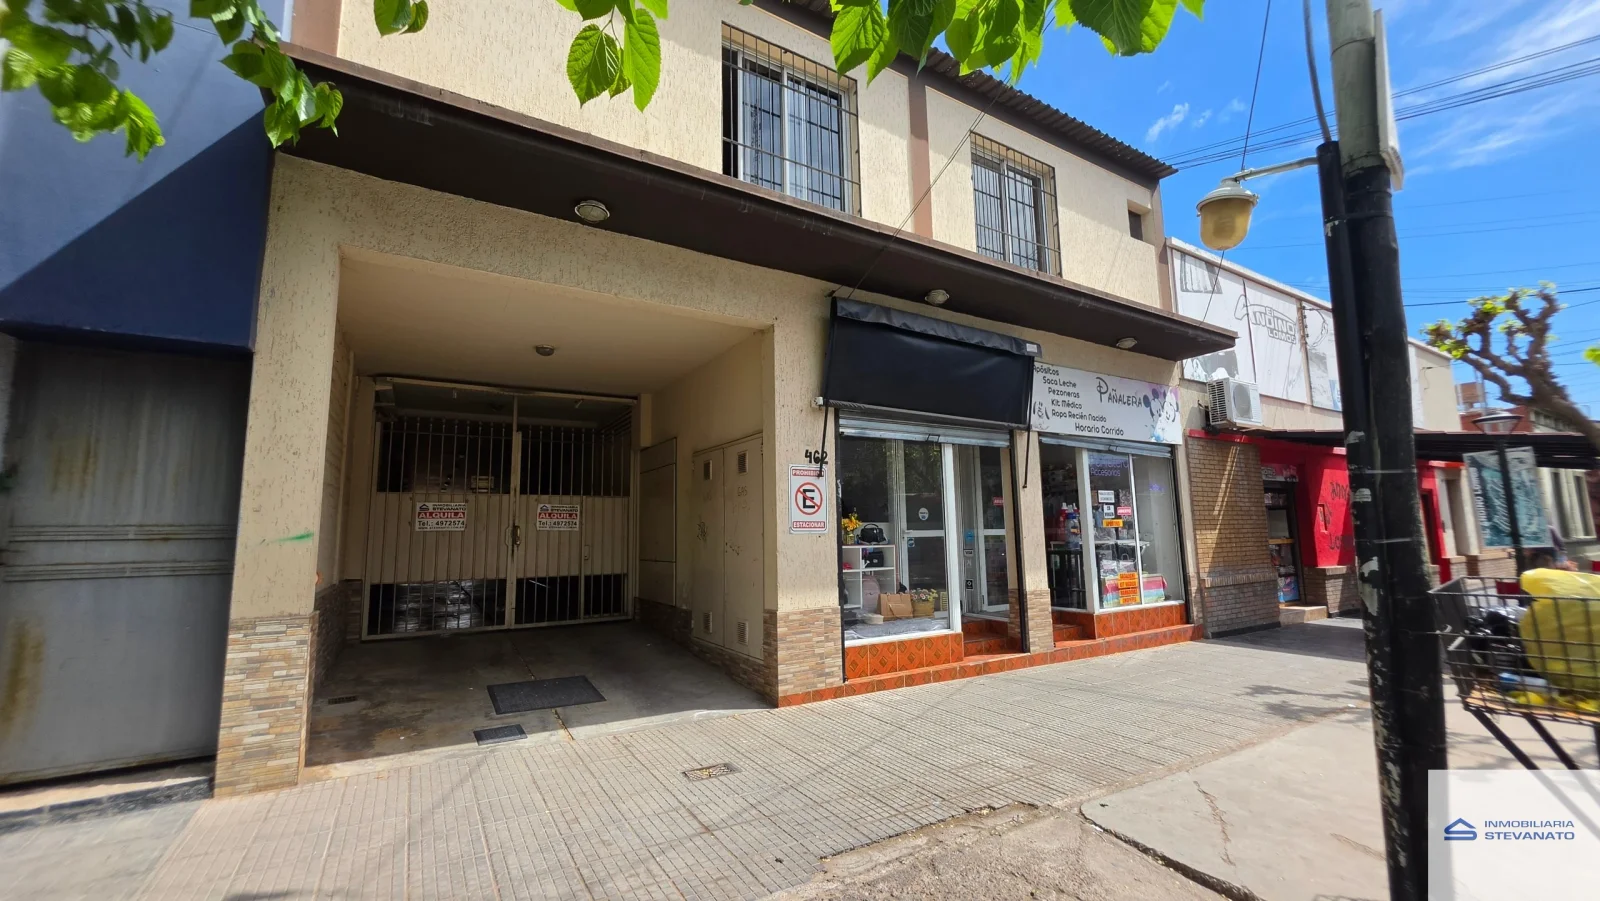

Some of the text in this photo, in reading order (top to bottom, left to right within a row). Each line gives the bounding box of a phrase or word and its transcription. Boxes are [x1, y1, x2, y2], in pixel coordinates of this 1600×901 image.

[1268, 330, 1296, 344] LOMOS
[1042, 376, 1077, 389] Saca Leche
[1048, 387, 1080, 399] Pezoneras
[1051, 399, 1061, 407] Kit
[1051, 409, 1067, 419] Ropa
[1068, 412, 1088, 421] Recién
[1075, 423, 1124, 437] Horario Corrido
[1091, 468, 1121, 477] Accesorios
